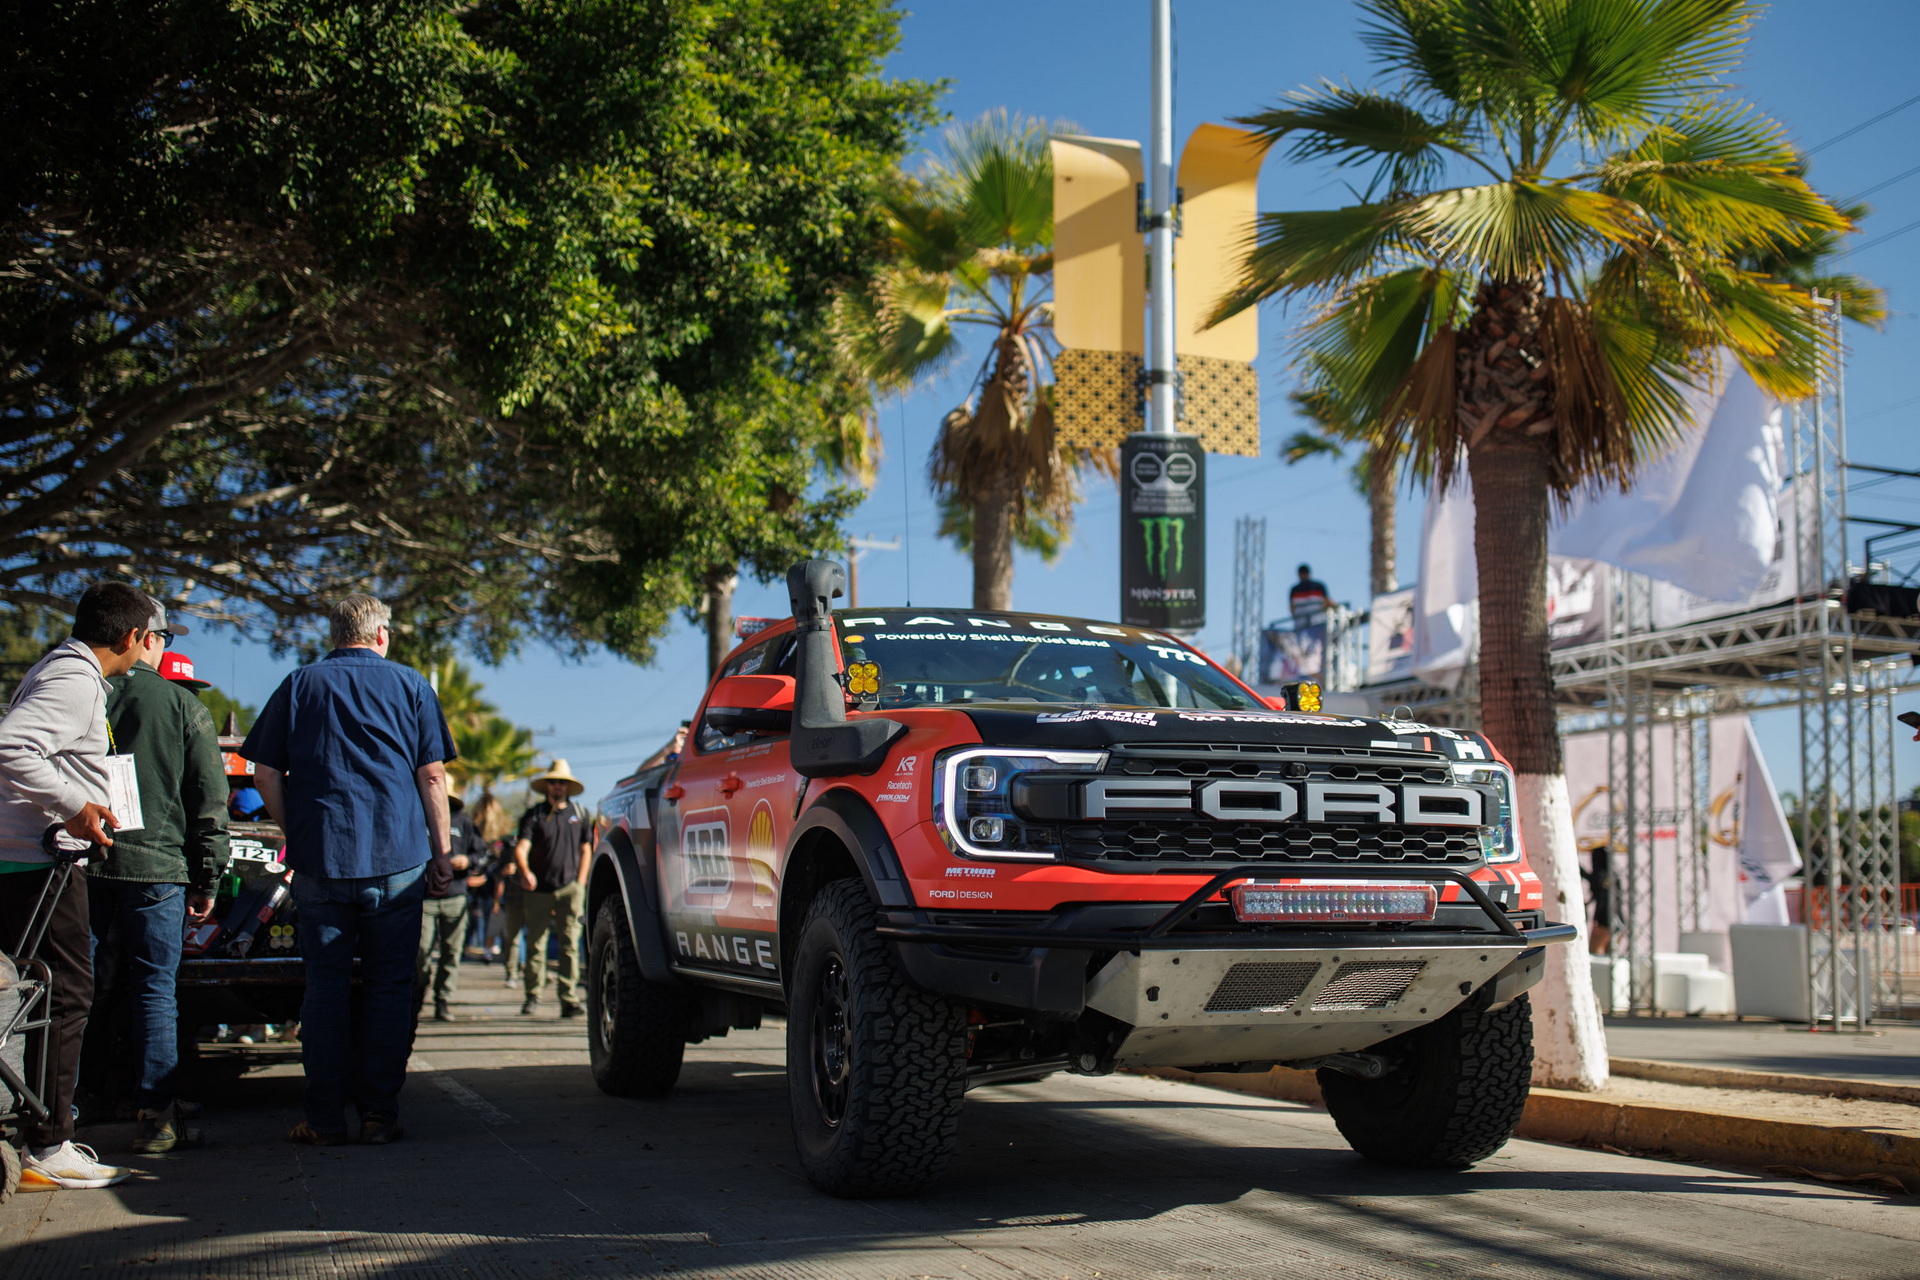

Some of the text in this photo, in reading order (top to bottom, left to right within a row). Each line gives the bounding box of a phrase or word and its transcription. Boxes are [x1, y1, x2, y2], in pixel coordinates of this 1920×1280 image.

[875, 633, 1111, 648] Powered by Shell Biofuel Blend
[1066, 714, 1158, 727] PERFORMANCE
[896, 756, 917, 772] KR
[887, 781, 912, 790] Racetech
[1086, 779, 1482, 826] FORD
[238, 847, 276, 862] 121
[686, 828, 731, 888] ARB
[945, 867, 996, 875] METHOD
[930, 890, 993, 899] FORD DESIGN
[676, 931, 776, 969] RANGE
